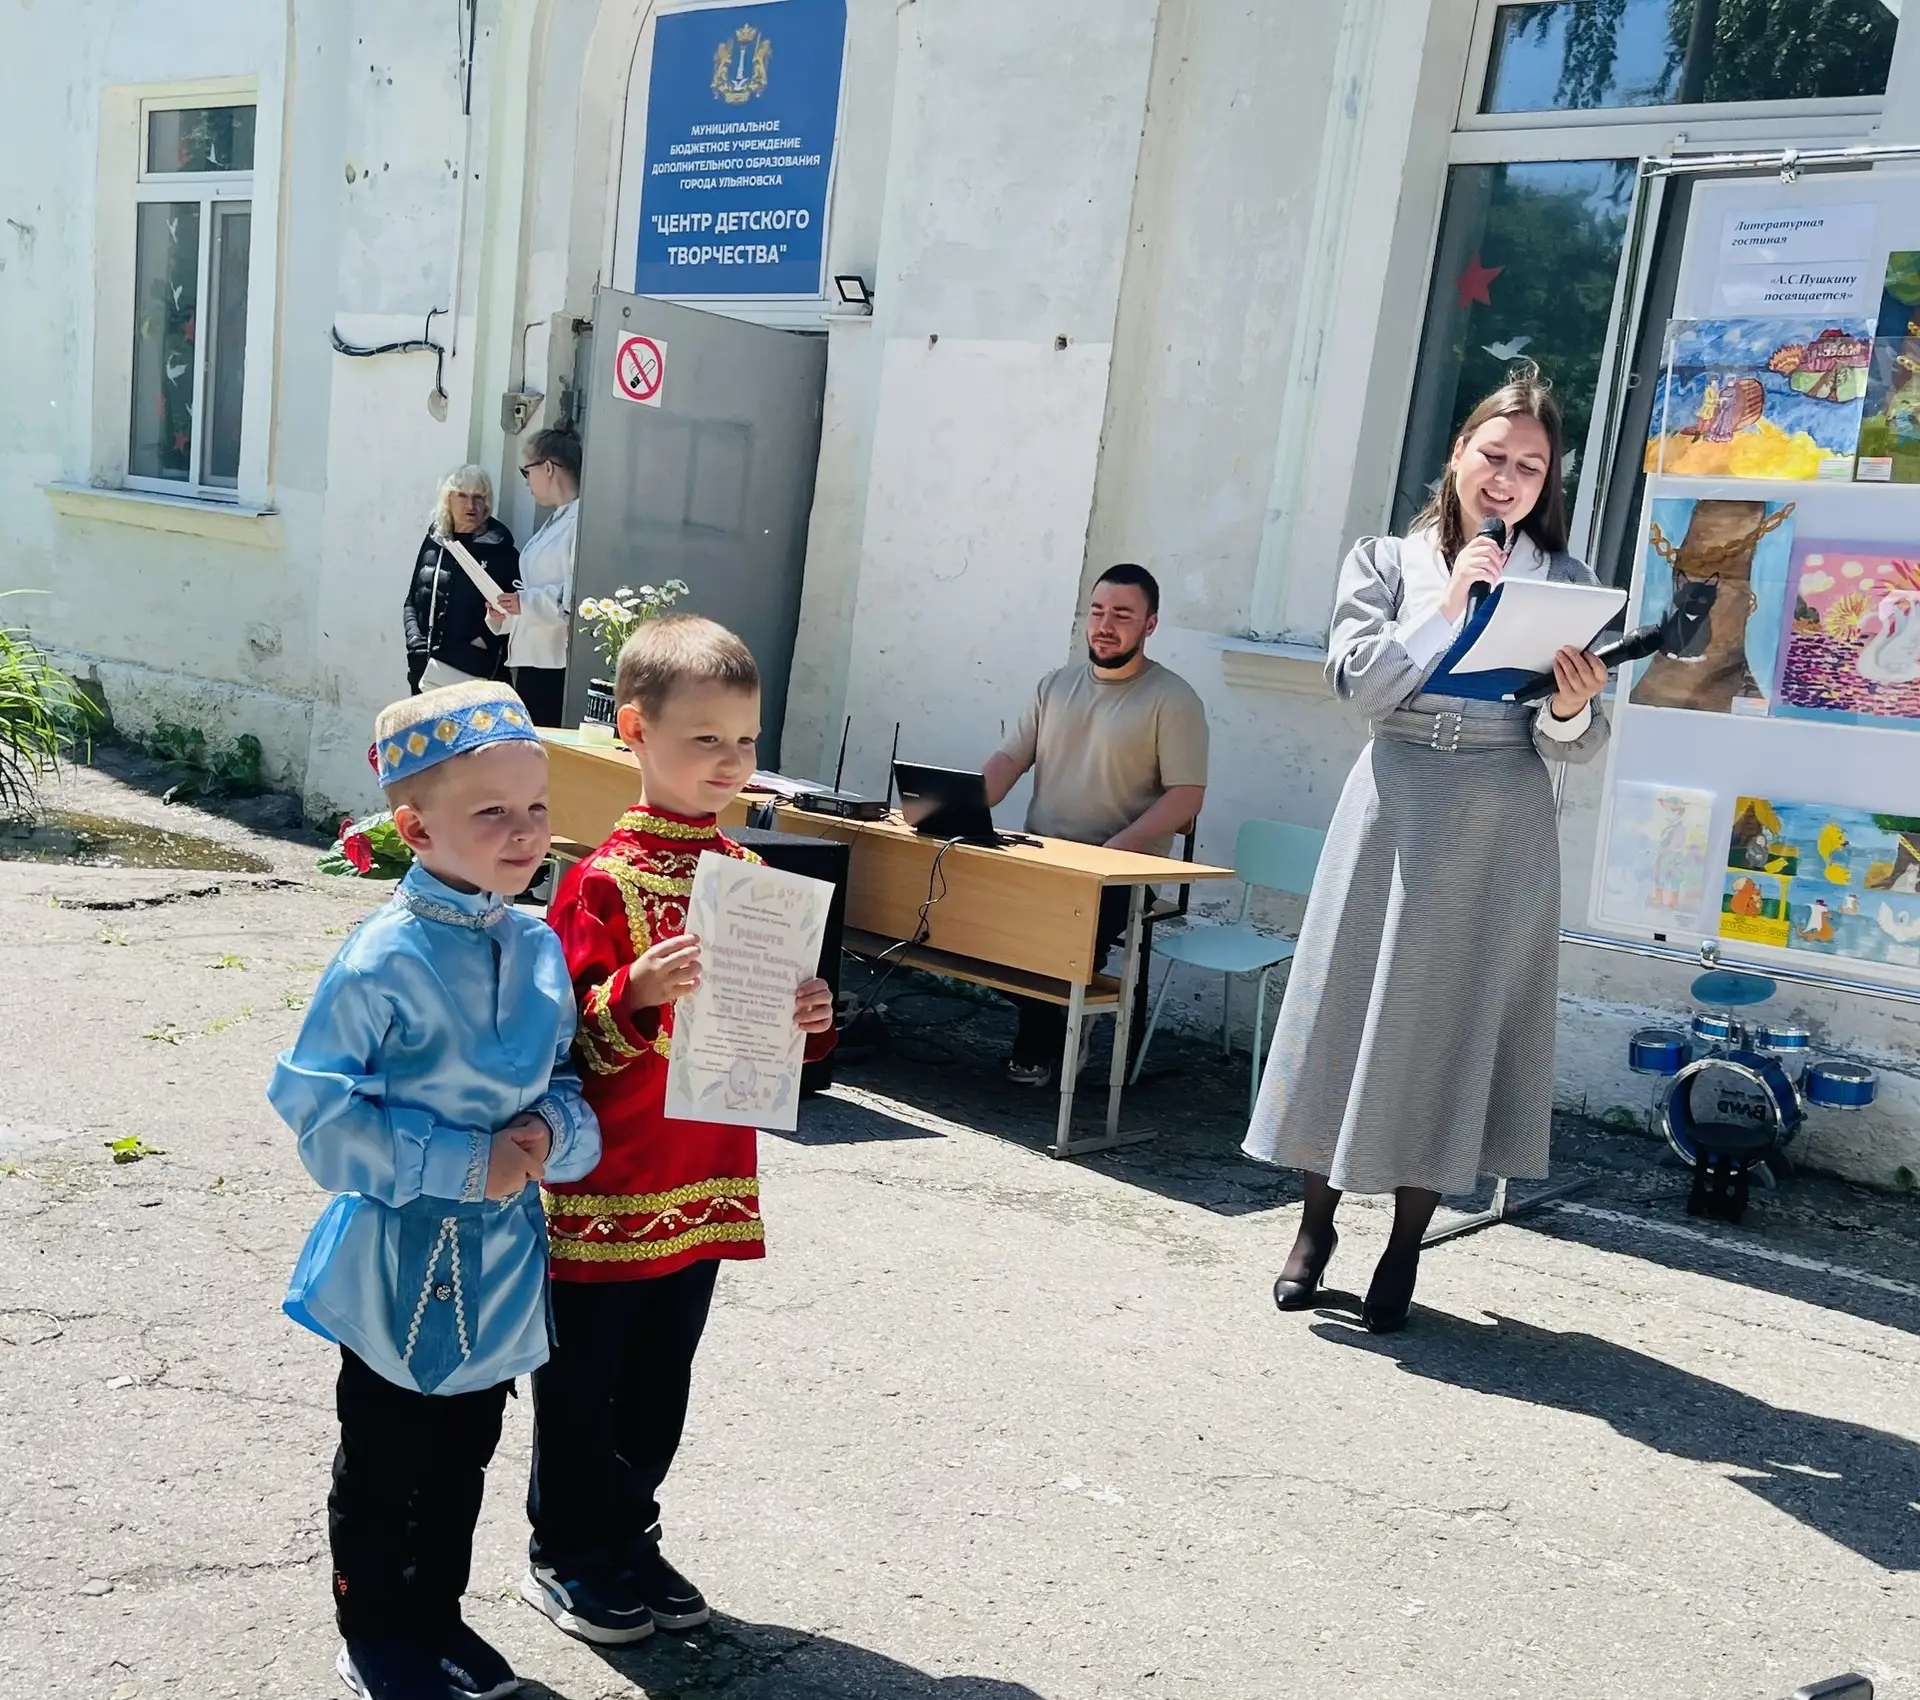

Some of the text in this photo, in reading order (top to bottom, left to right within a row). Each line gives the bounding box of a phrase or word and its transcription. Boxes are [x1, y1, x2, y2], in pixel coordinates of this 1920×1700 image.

[691, 120, 780, 136] МУНИЦИПАЛЬНОЕ
[670, 137, 801, 156] БЮДЖЕТНОЕ УЧРЕЖДЕНИЕ
[651, 155, 820, 176] ДОПОЛНИТЕЛЬНОГО ОБРАЗОВАНИЯ
[680, 175, 782, 190] ГОРОДА УЛЬЯНОВСКА
[651, 209, 810, 236] "ЦЕНТР ДЕТСКОГО
[1734, 218, 1824, 232] Литературная
[1732, 236, 1787, 246] гостиная
[668, 244, 787, 265] ТВОРЧЕСТВА"
[1764, 291, 1853, 302] посвящается»
